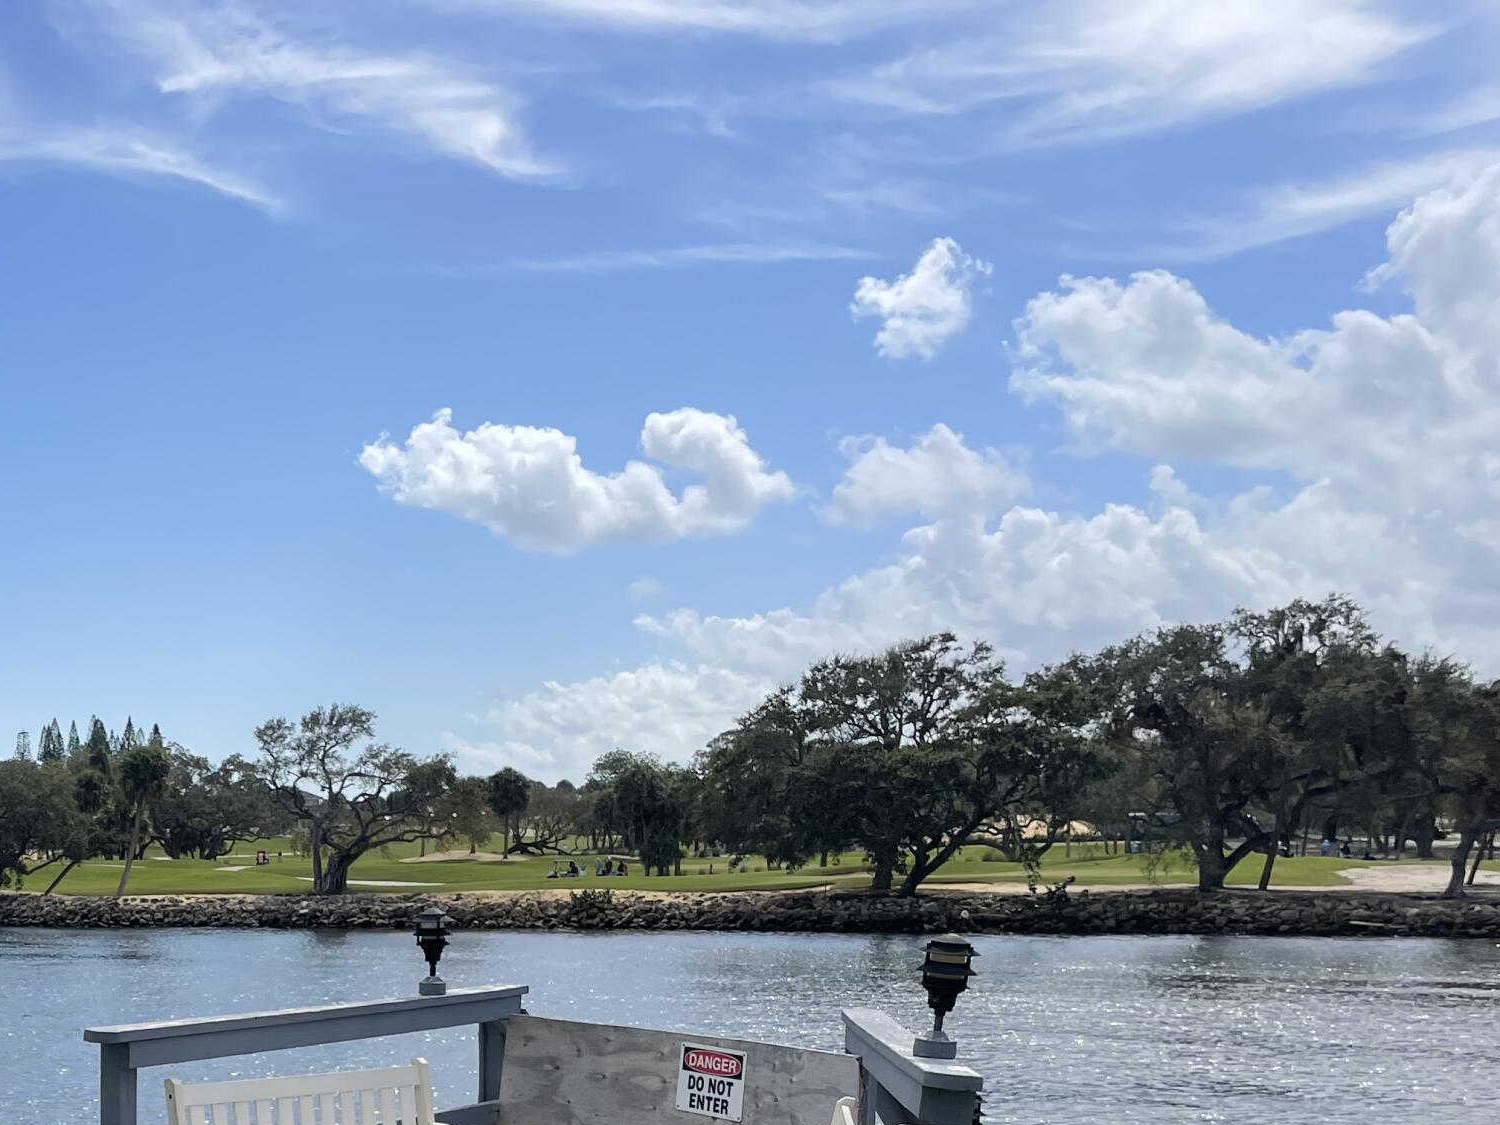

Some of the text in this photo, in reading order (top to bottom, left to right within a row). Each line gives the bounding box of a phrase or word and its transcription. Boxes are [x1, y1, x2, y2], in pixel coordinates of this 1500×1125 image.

[689, 1053, 736, 1073] DANGER
[688, 1075, 733, 1097] DO NOT
[689, 1093, 729, 1115] ENTER
